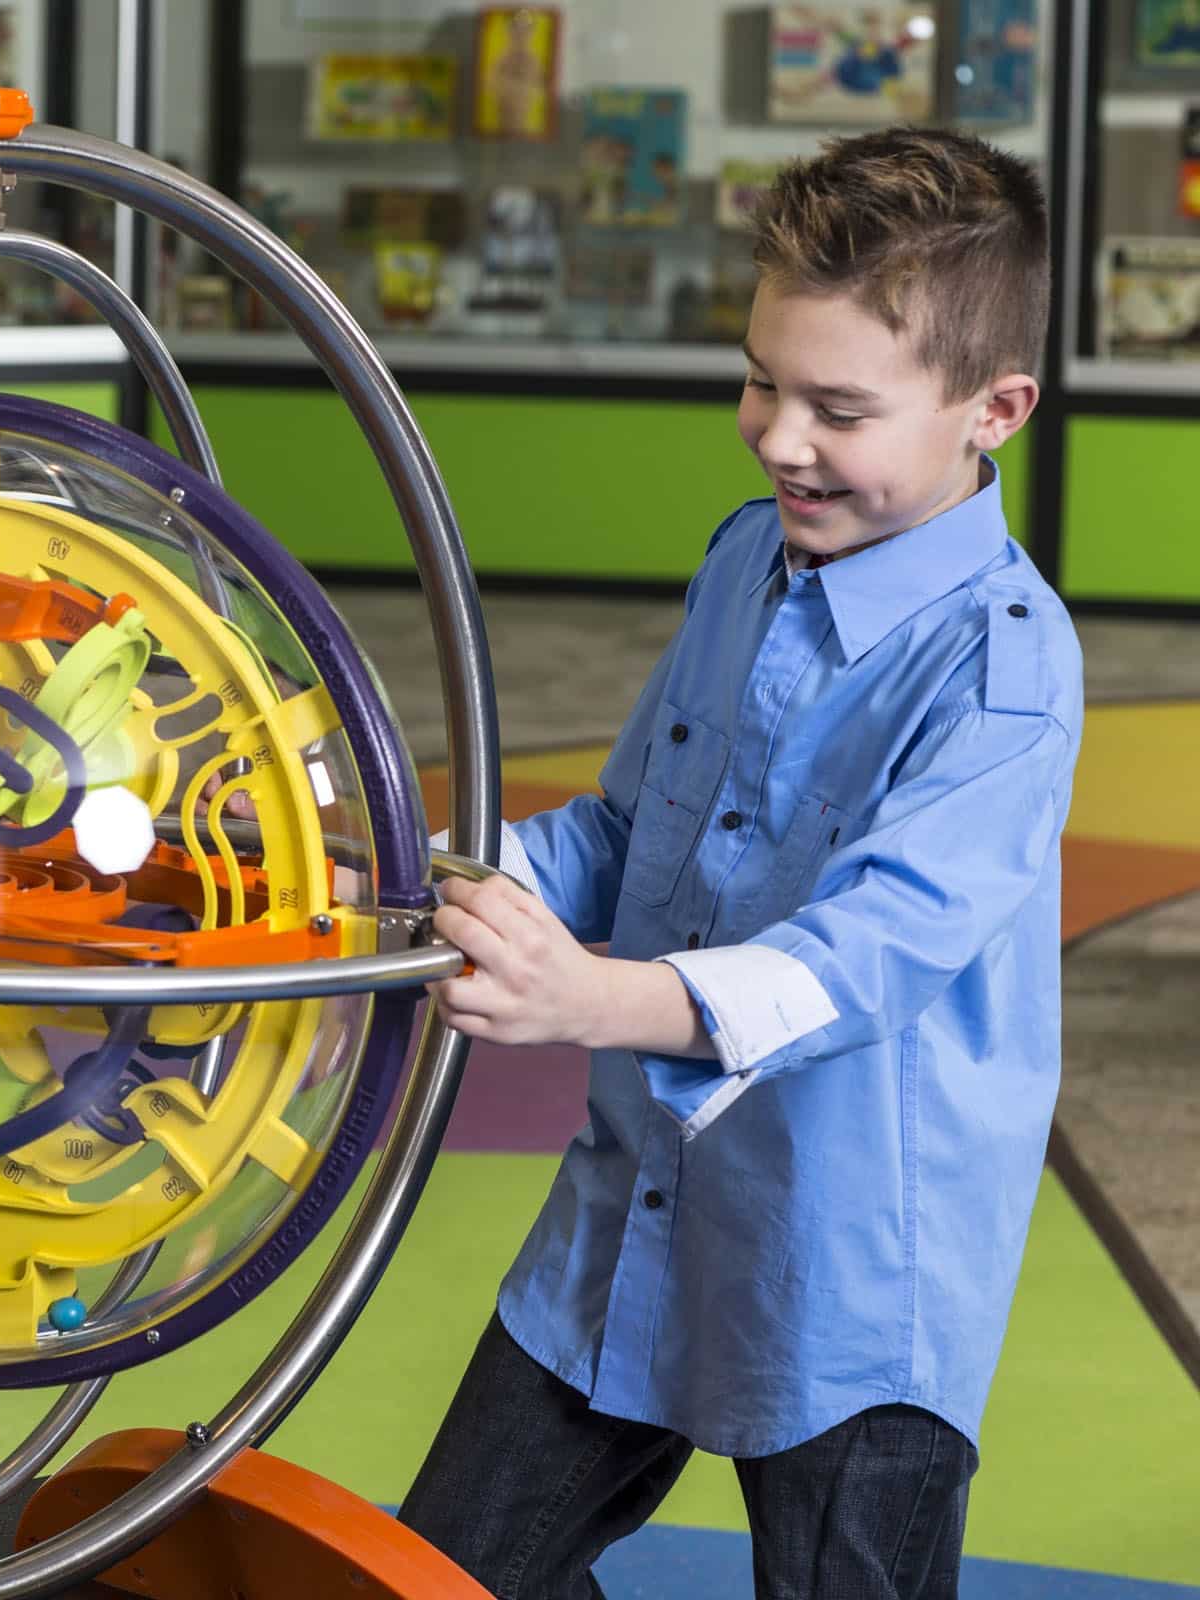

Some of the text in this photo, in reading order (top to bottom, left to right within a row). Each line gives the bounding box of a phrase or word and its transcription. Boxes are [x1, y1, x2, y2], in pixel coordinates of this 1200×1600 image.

[47, 536, 70, 560] 49
[280, 888, 299, 909] 72
[63, 1139, 94, 1160] 106
[3, 1160, 26, 1185] 61
[161, 1176, 186, 1202] 62
